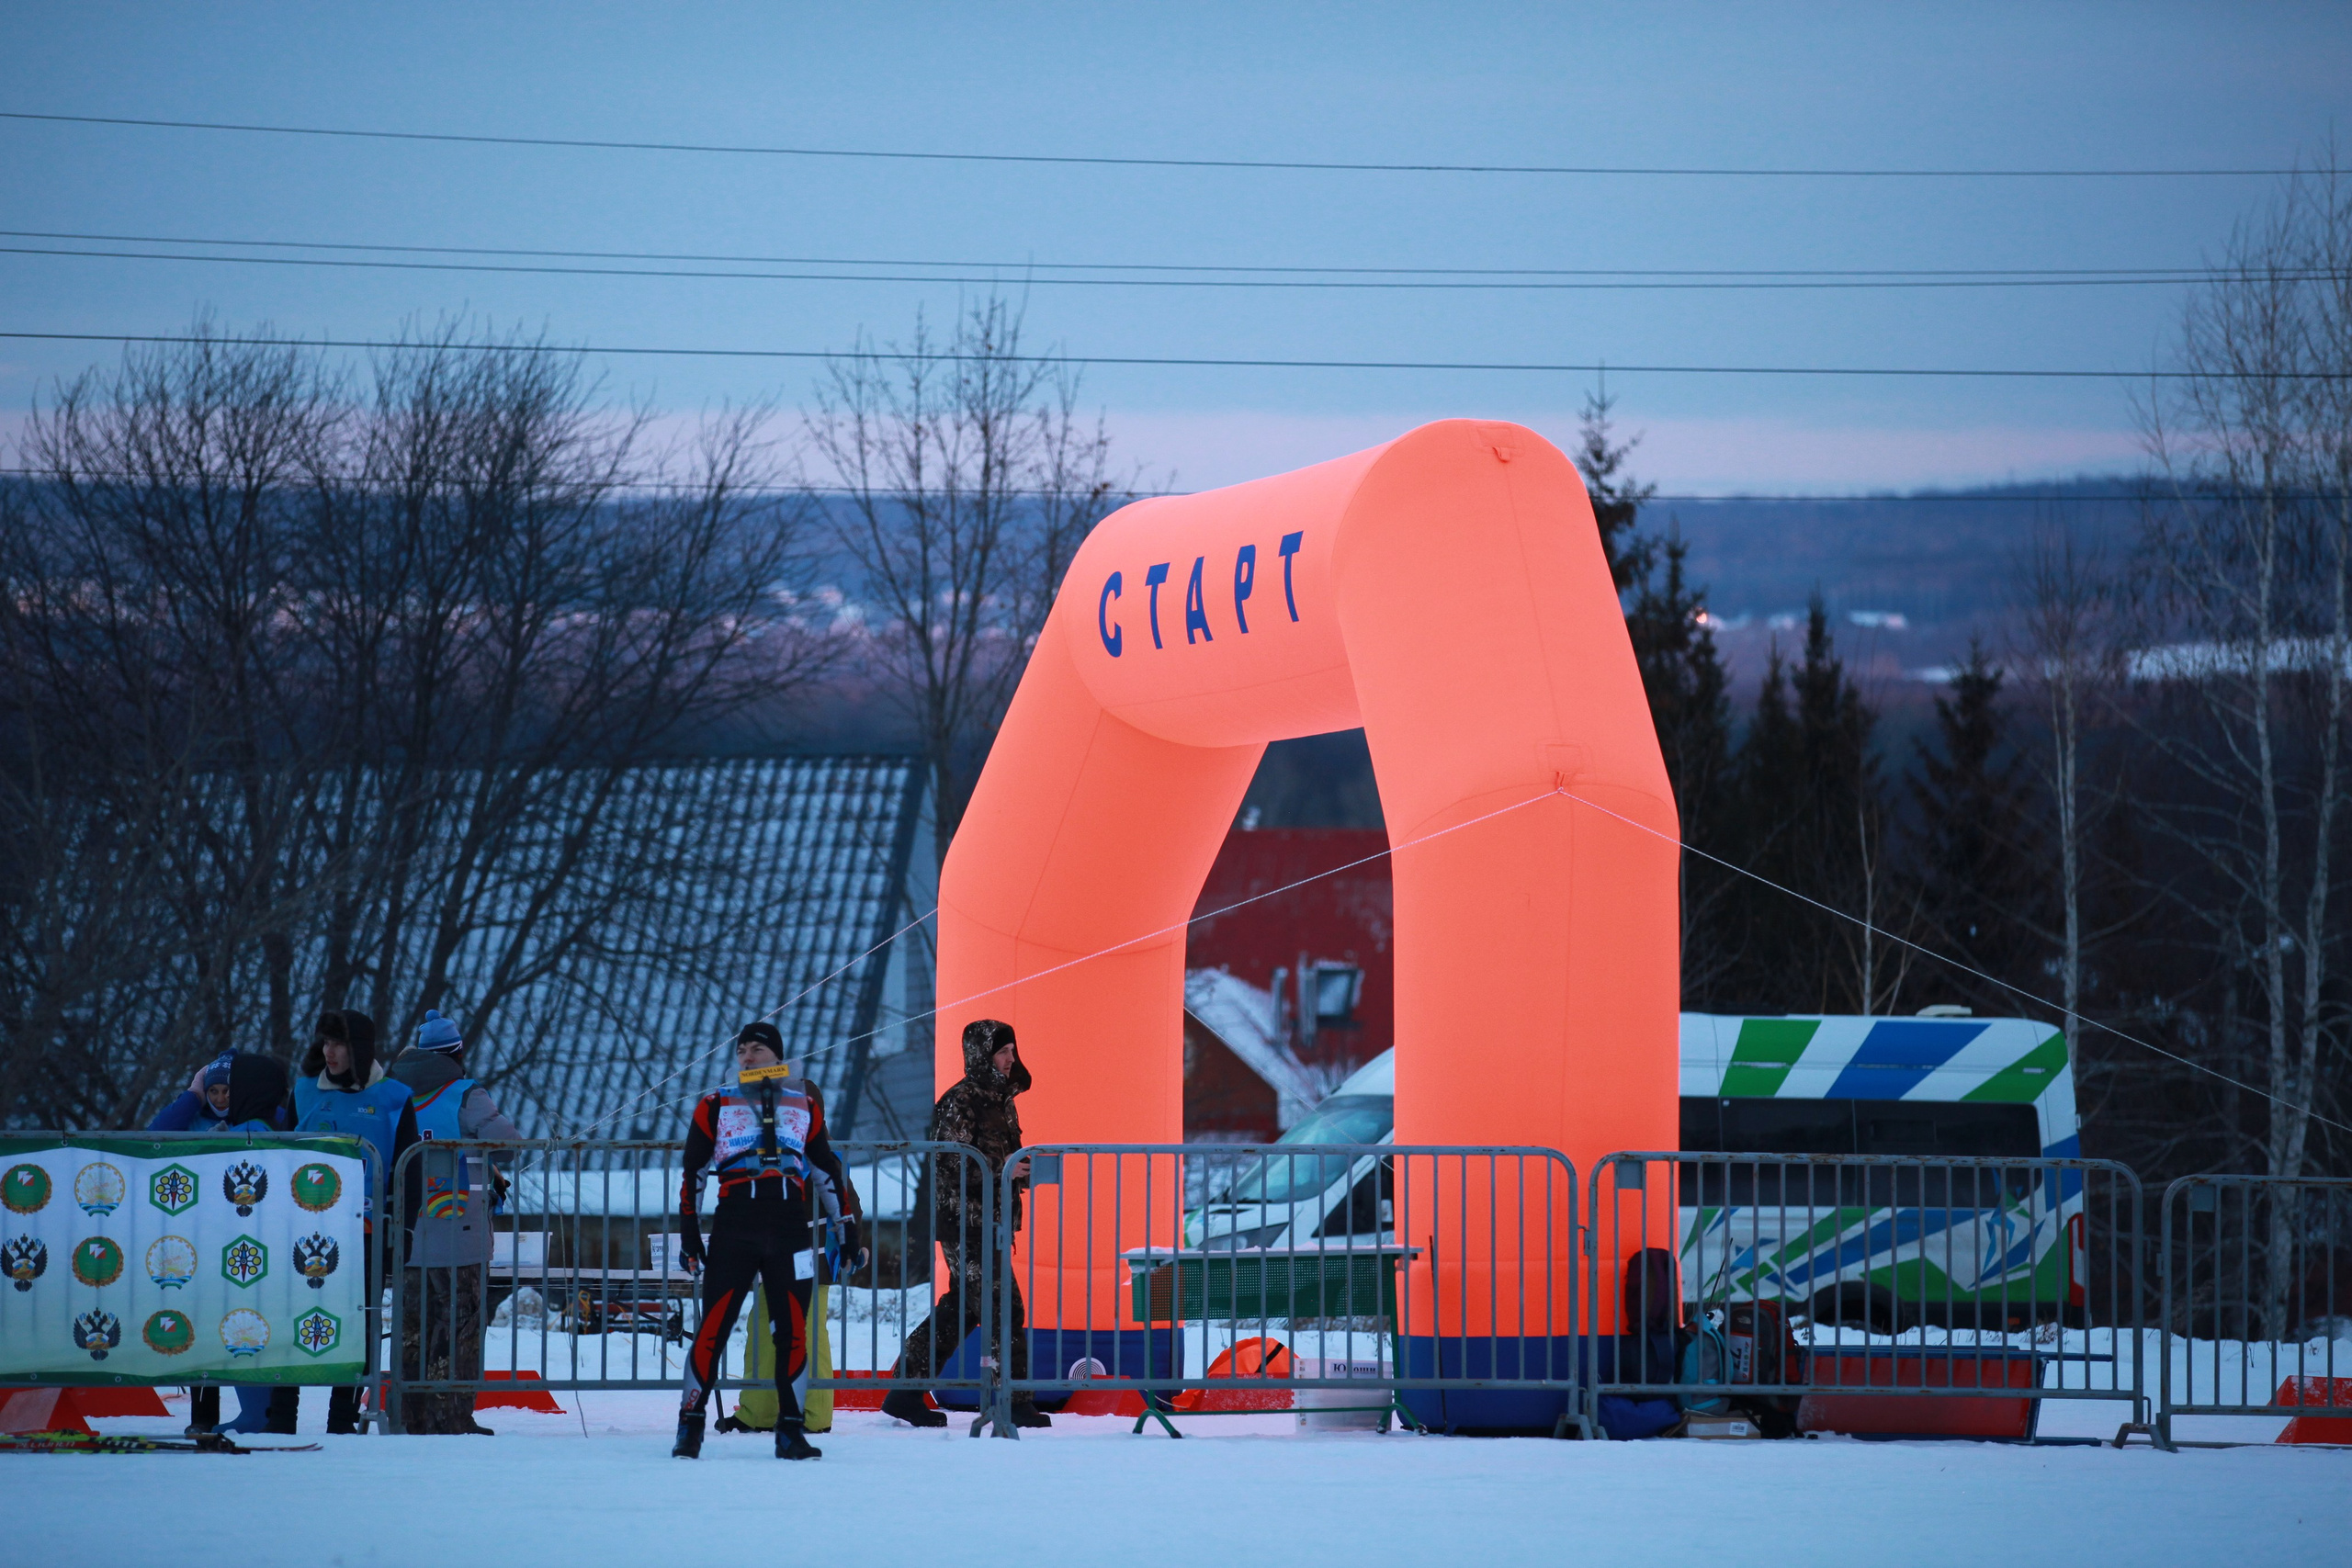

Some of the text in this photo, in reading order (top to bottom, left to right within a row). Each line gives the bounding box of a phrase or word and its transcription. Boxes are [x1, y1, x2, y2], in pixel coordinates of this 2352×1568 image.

[1099, 530, 1304, 658] СТАРТ
[741, 1066, 786, 1077] NORDENMARK
[1333, 1363, 1376, 1374] Юоши
